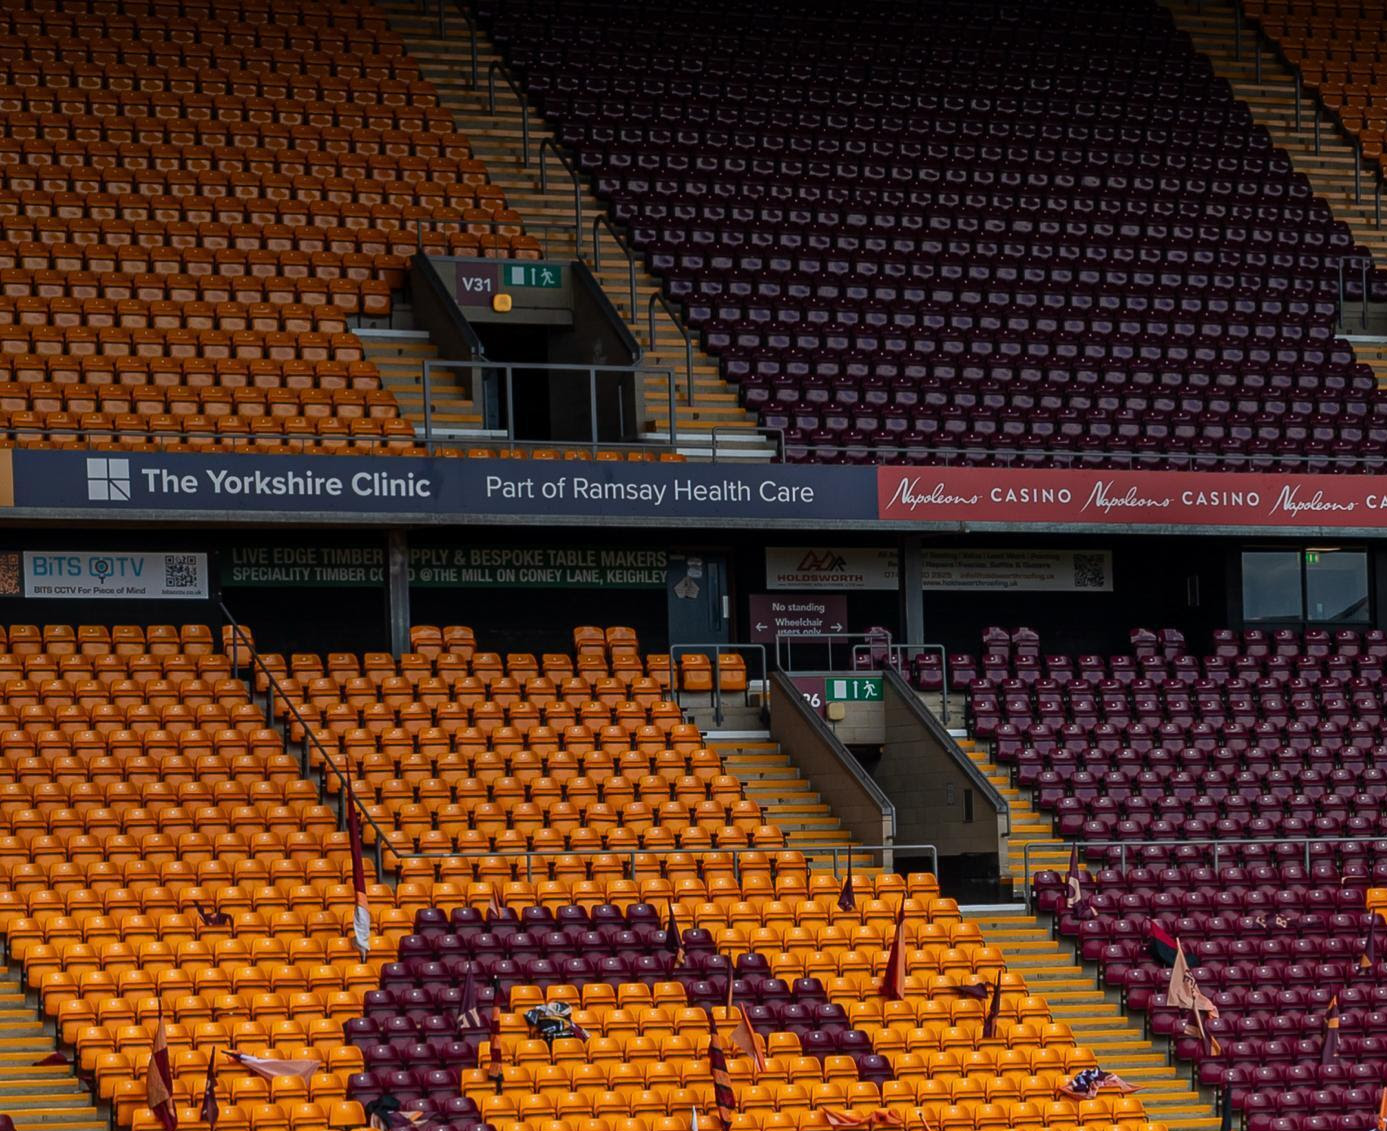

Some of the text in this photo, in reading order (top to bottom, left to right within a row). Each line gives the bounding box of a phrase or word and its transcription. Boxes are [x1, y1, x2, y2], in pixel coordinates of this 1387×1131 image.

[462, 277, 492, 292] V31
[141, 468, 432, 498] The Yorkshire Clinic
[486, 476, 814, 506] Part of Ramsay Health Care
[887, 476, 1072, 512] Napoleons CASINO
[1080, 480, 1260, 514] Napoleons CASINO
[1269, 484, 1359, 517] Napoleons
[233, 547, 667, 568] LIVE EDGE TIMBER & BESPOKE TABLE MAKERS
[233, 567, 309, 582] SPECIALITY
[314, 567, 365, 582] TIMBER
[462, 568, 492, 582] MILL
[497, 569, 516, 583] ON
[519, 569, 562, 584] CONEY
[566, 569, 604, 586] LANE,
[607, 569, 668, 584] KEIGHLEY
[54, 586, 76, 594] CCTV
[772, 603, 825, 613] No standing
[775, 618, 823, 626] Wheelchair
